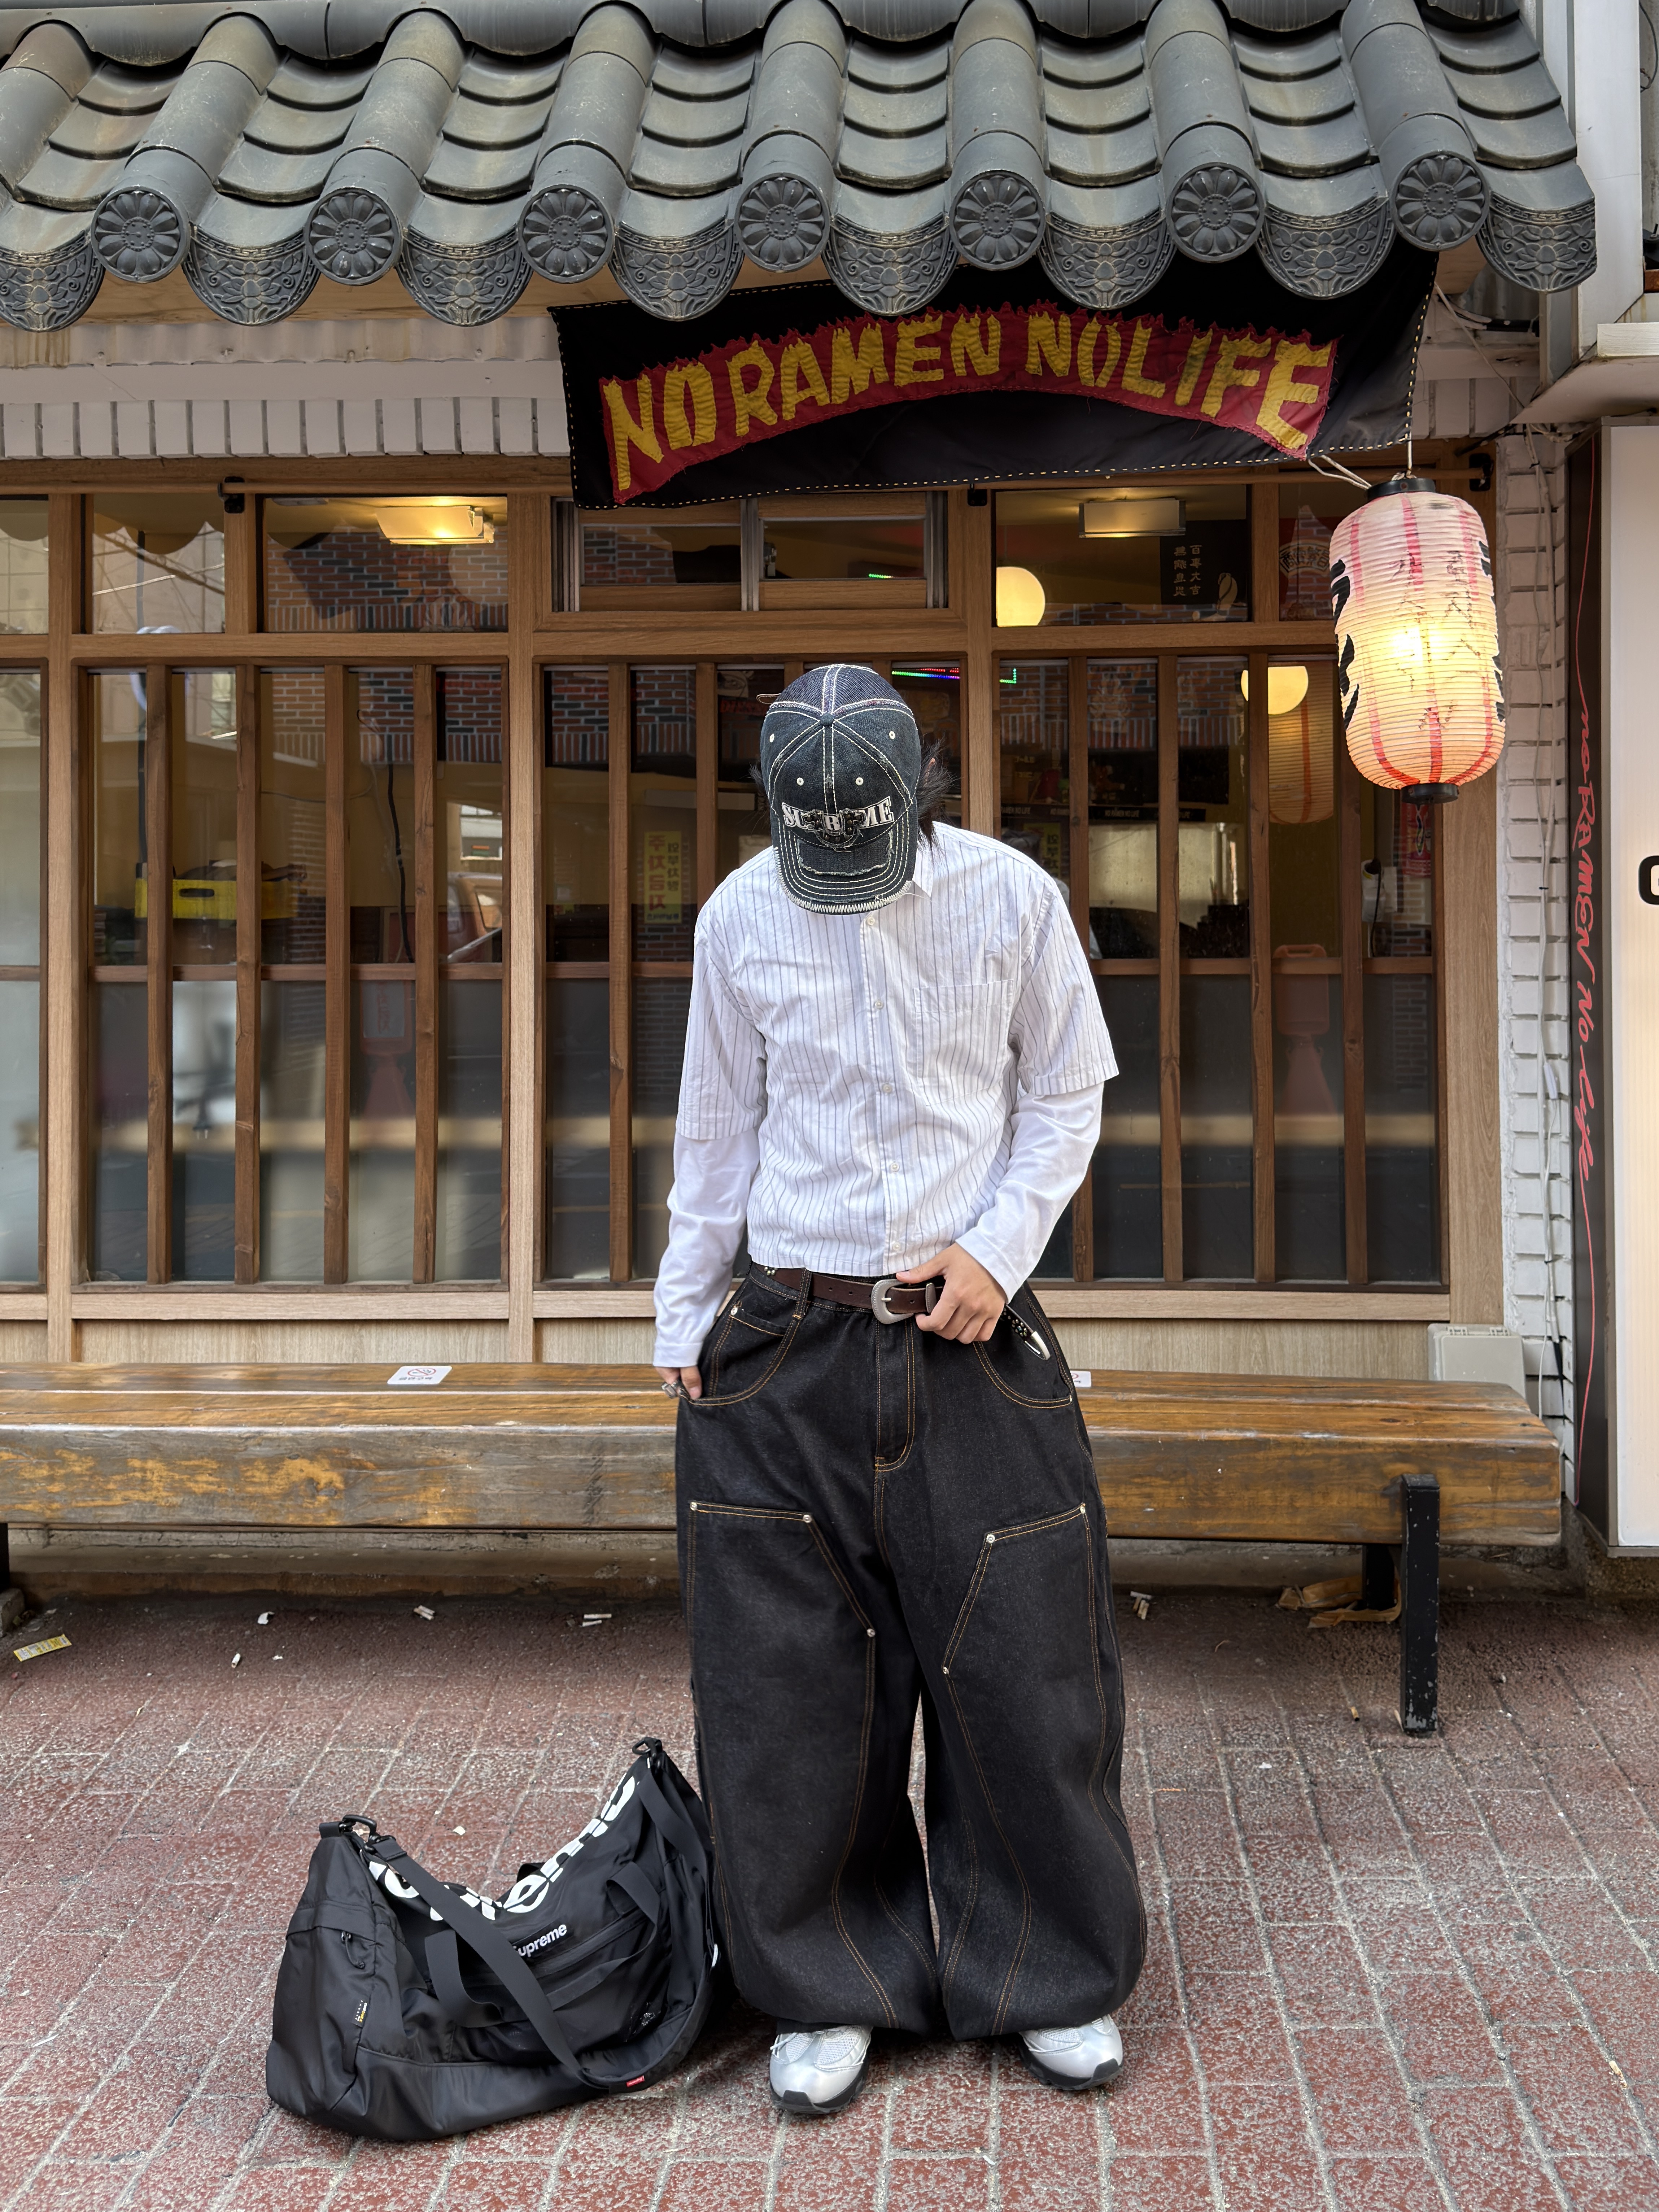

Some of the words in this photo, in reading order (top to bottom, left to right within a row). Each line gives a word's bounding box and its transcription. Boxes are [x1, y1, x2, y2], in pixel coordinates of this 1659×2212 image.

[603, 363, 717, 491] NO
[726, 313, 1001, 436] RAMEN
[1027, 311, 1122, 388] NO
[1121, 318, 1332, 450] LIFE
[781, 795, 894, 830] SURME
